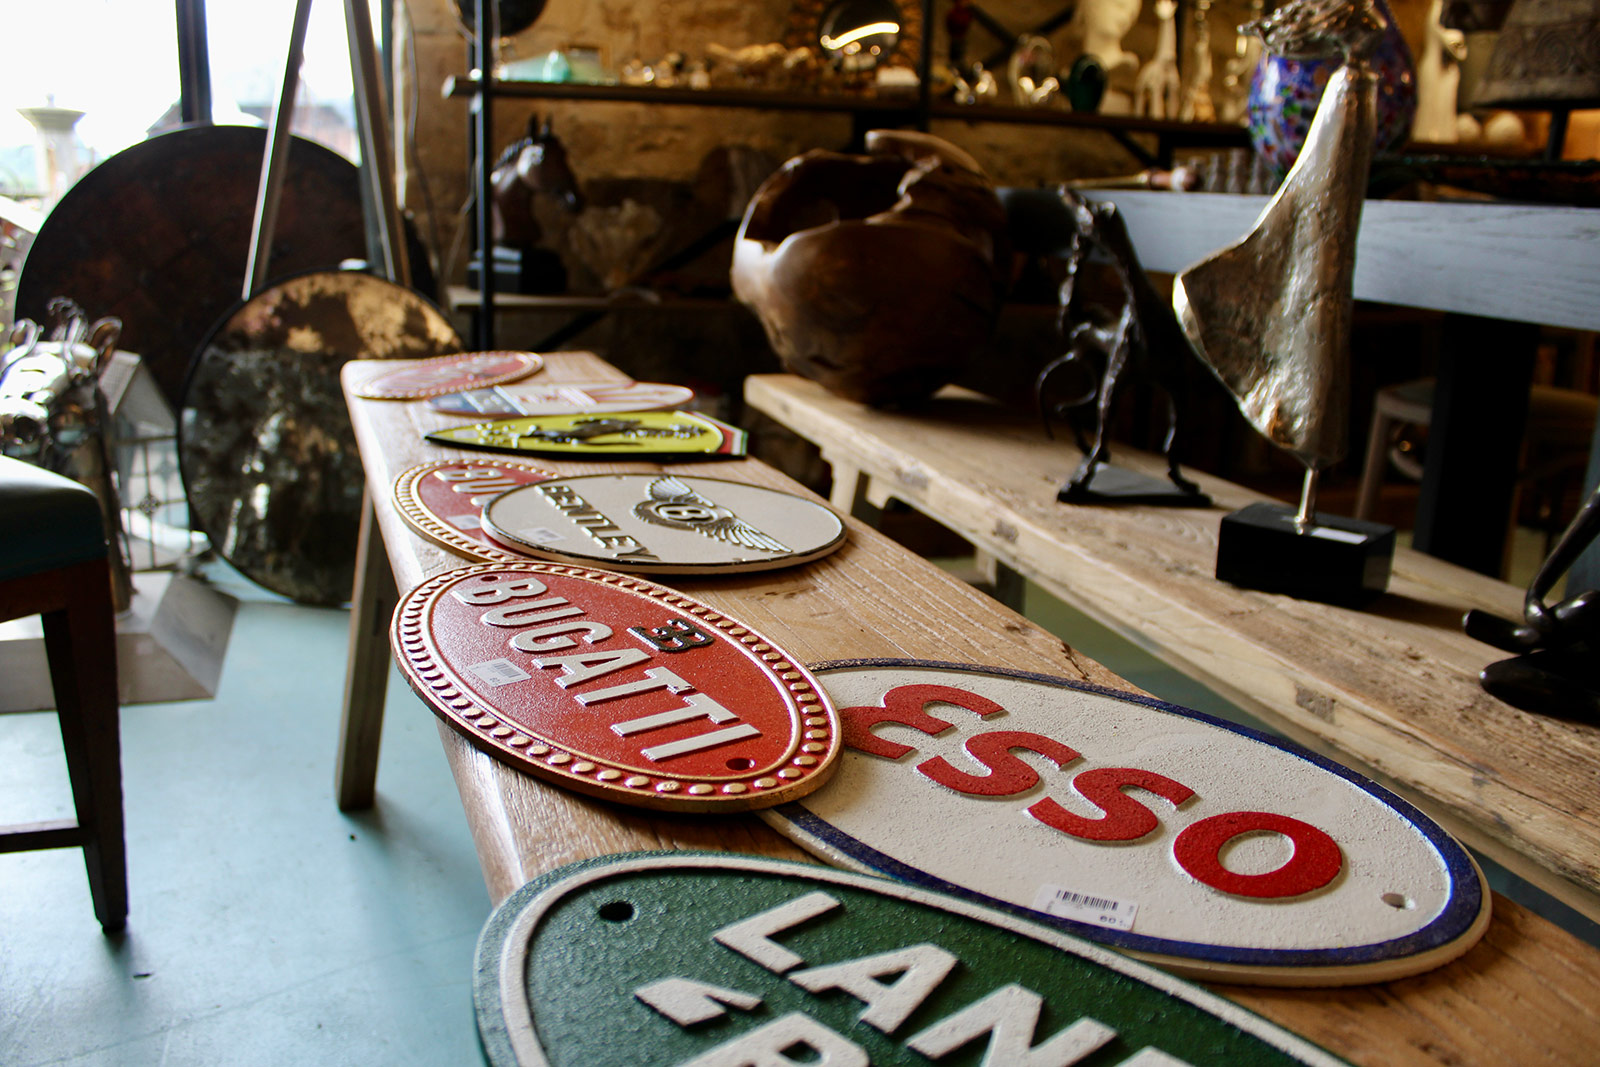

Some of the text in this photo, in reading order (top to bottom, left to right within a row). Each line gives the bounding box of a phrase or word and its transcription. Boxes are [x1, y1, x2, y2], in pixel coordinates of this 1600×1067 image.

[534, 484, 661, 561] BENTLEY
[452, 577, 763, 762] BUGATTI
[837, 683, 1343, 898] ESSO
[712, 890, 1196, 1067] LAN
